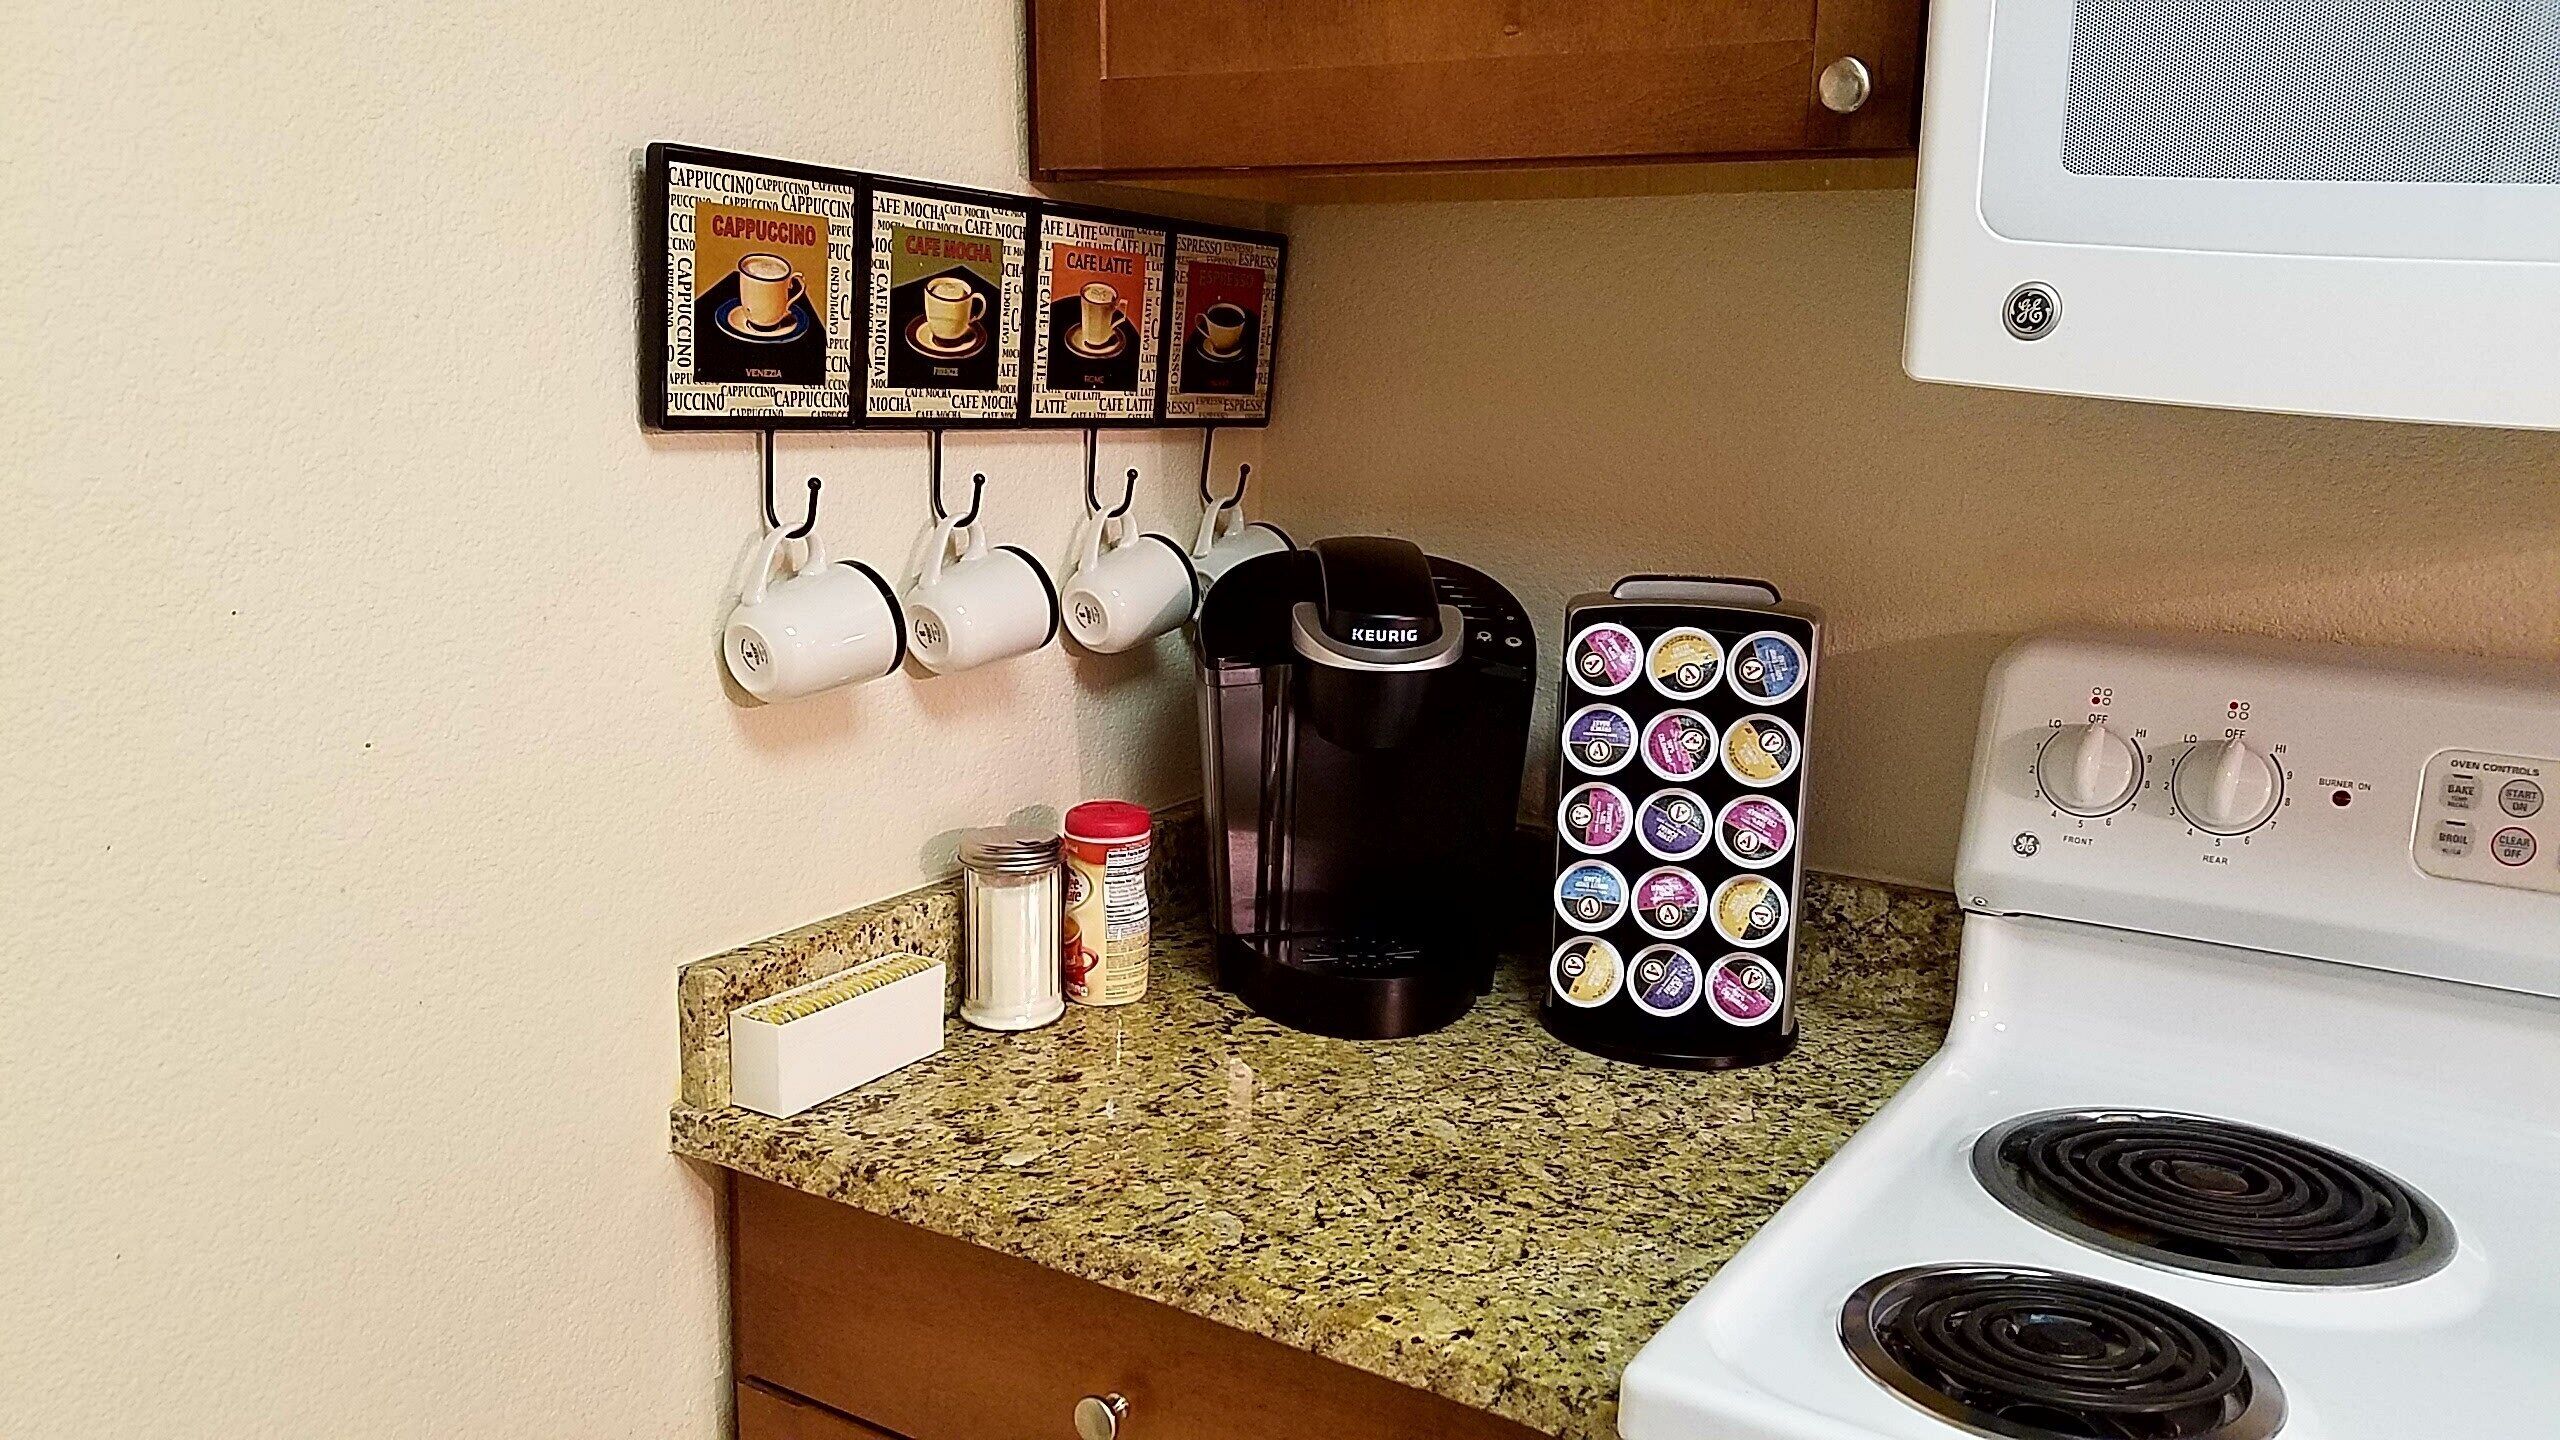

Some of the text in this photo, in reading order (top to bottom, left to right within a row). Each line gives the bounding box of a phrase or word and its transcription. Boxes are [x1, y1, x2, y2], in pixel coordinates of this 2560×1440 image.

[669, 167, 754, 195] CAPPUCCINO
[756, 178, 810, 195] CAPPUCCINO
[904, 200, 946, 221] MOCHA
[712, 215, 816, 246] CAPPUCCINO
[965, 219, 992, 236] CAFE
[1066, 222, 1098, 240] LATTE
[905, 235, 941, 257] CAFE
[943, 240, 992, 263] MOCHA
[1177, 237, 1222, 255] ESPRESSO
[1066, 252, 1097, 271] CAFE
[1099, 256, 1133, 275] LATTE
[830, 267, 840, 335] CAPPUCCINO
[677, 258, 692, 368] CAPPUCCINO
[874, 273, 888, 377] CAFE MOCHA
[745, 369, 782, 378] VENEZIA
[721, 385, 775, 397] CAPPUCCINO
[774, 391, 849, 408] CAPPUCCINO
[869, 397, 911, 412] MOCHA
[952, 395, 978, 408] CAFE
[1099, 398, 1123, 411] CAFE
[1035, 399, 1067, 414] LATTE
[1352, 628, 1418, 642] KEURIG
[2049, 719, 2062, 728] LO
[2088, 714, 2108, 724] OFF
[2135, 729, 2147, 738] HI
[2225, 729, 2246, 740] OFF
[2184, 734, 2197, 744] LO
[2275, 744, 2287, 753] HI
[2171, 758, 2176, 766] 1
[2029, 765, 2035, 774] 2
[2450, 760, 2540, 776] OVEN CONTROLS
[2287, 771, 2293, 780] 9
[2144, 780, 2150, 789] 8
[2164, 782, 2170, 790] 2
[2319, 777, 2371, 791] BURNER ON
[2034, 790, 2040, 798] 3
[2447, 784, 2475, 795] BAKE
[2505, 789, 2538, 799] START
[2131, 803, 2137, 811] 7
[2284, 798, 2291, 806] 8
[2512, 802, 2528, 811] ON
[2051, 810, 2057, 818] 4
[2169, 807, 2175, 816] 3
[2078, 820, 2083, 828] 5
[2105, 818, 2111, 826] 6
[2271, 821, 2277, 830] 7
[2187, 828, 2193, 836] 4
[2063, 835, 2093, 845] FRONT
[2215, 838, 2221, 847] 5
[2244, 836, 2250, 845] 6
[2439, 832, 2468, 844] BROIL
[2499, 836, 2530, 847] CLEAR
[2504, 849, 2522, 858] OFF
[2203, 855, 2228, 865] REAR
